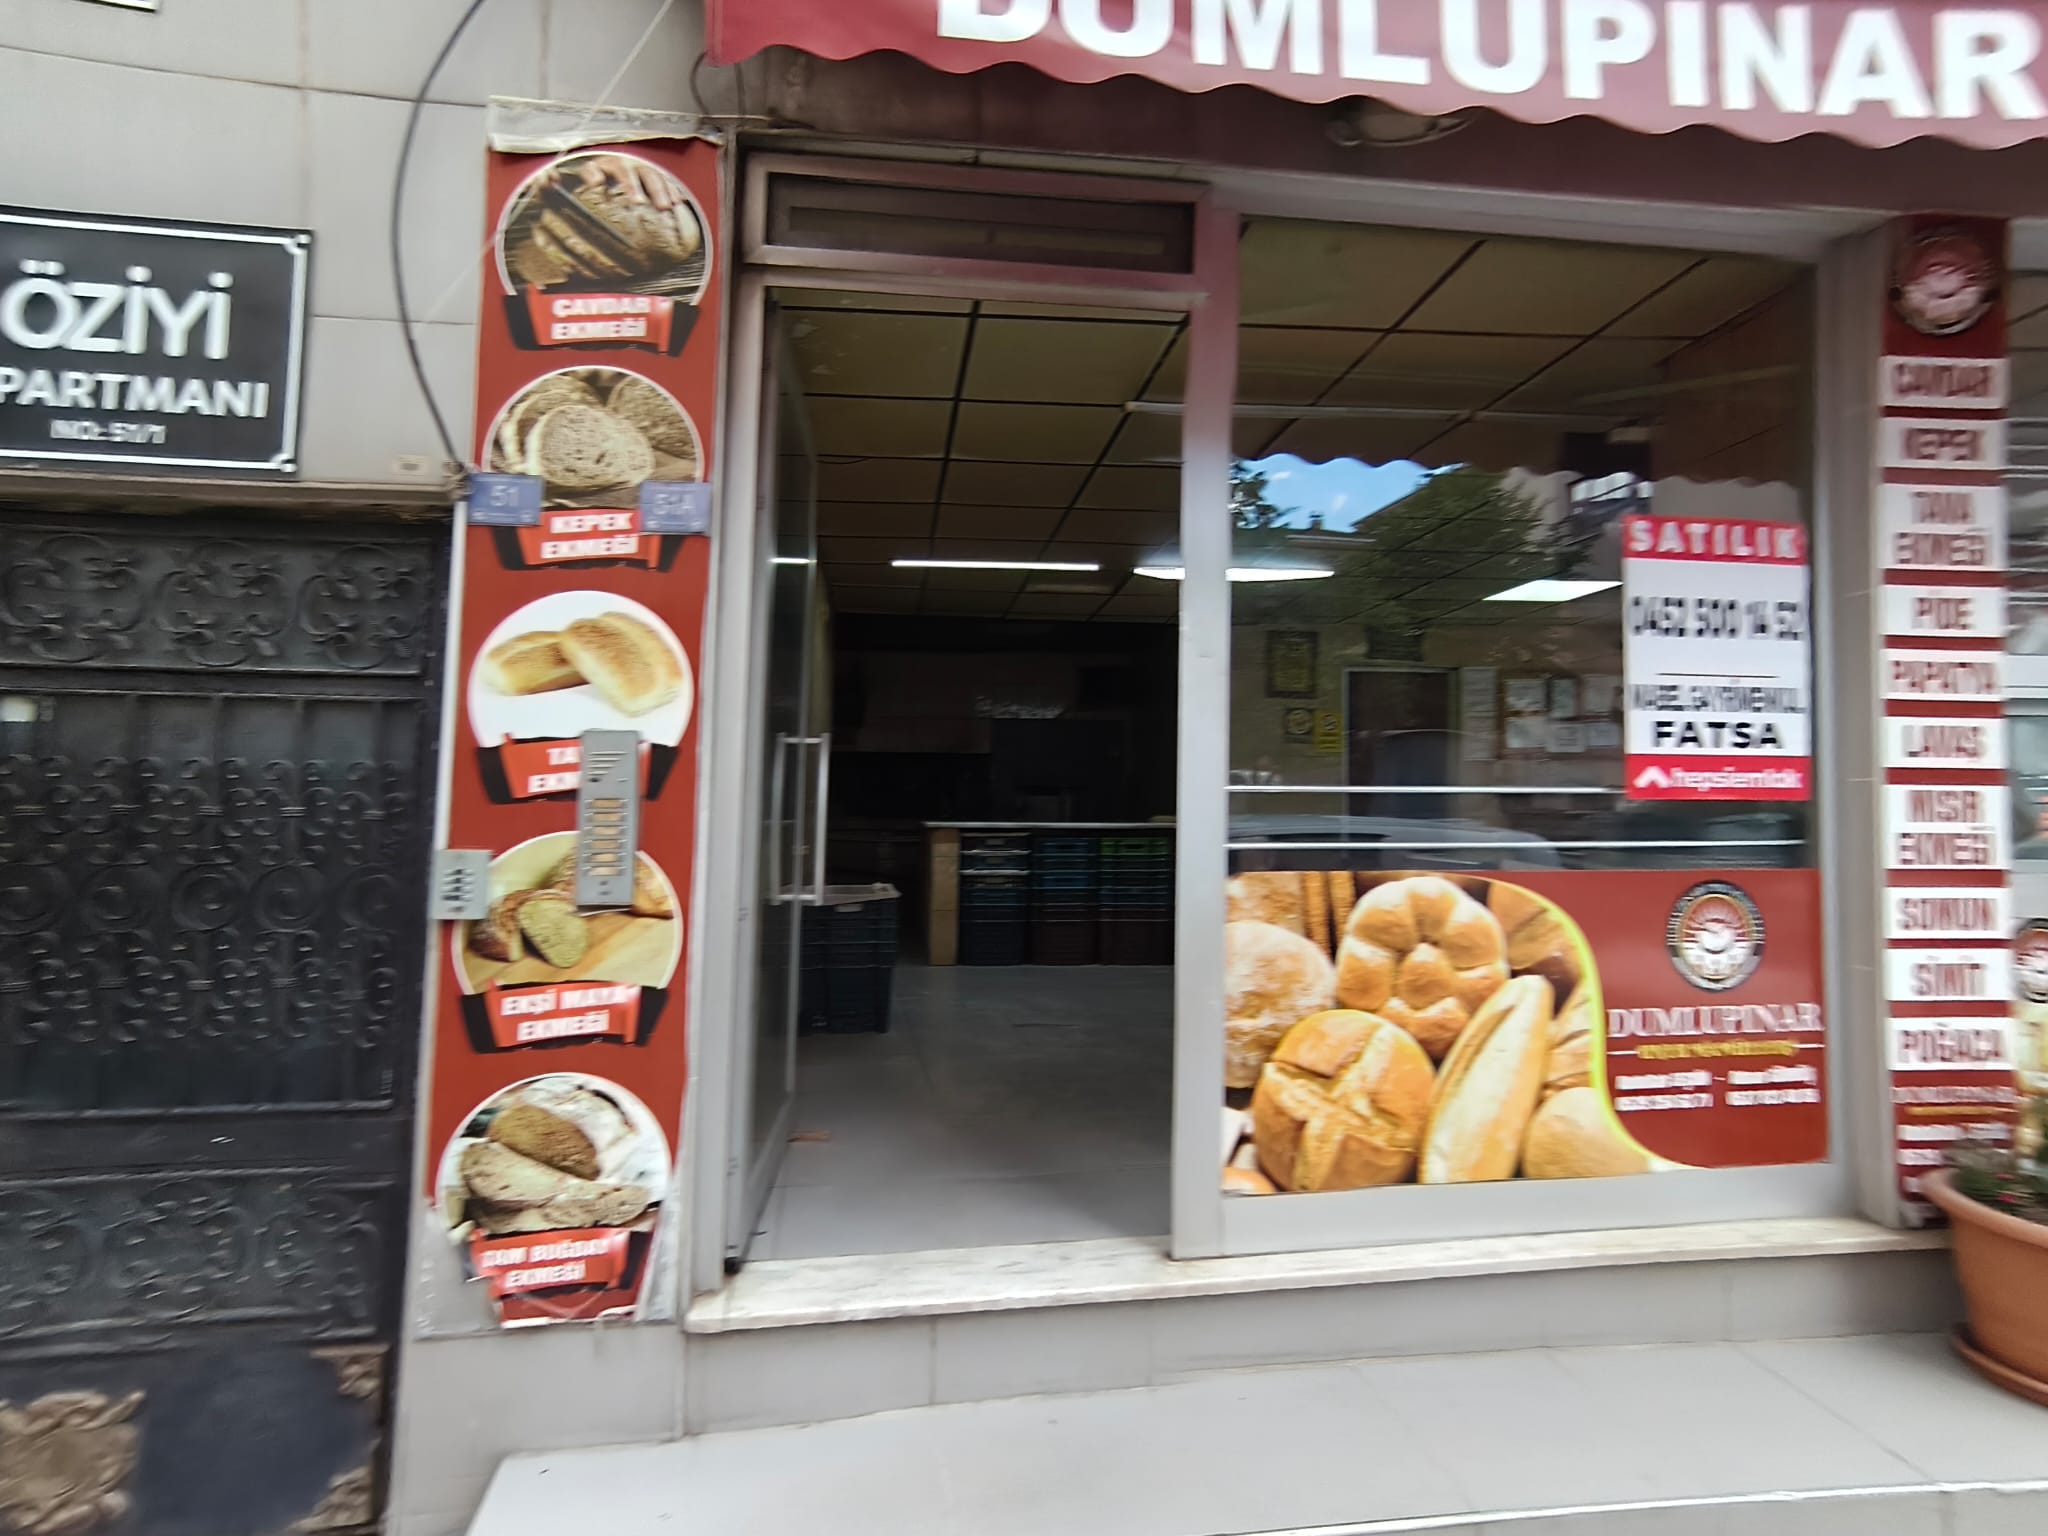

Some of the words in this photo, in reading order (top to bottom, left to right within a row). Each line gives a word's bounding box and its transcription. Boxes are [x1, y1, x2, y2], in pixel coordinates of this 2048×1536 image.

[0, 258, 235, 360] ÖZİYİ
[489, 484, 520, 507] 51
[1629, 519, 1801, 559] SATILIK
[1653, 720, 1784, 749] FATSA
